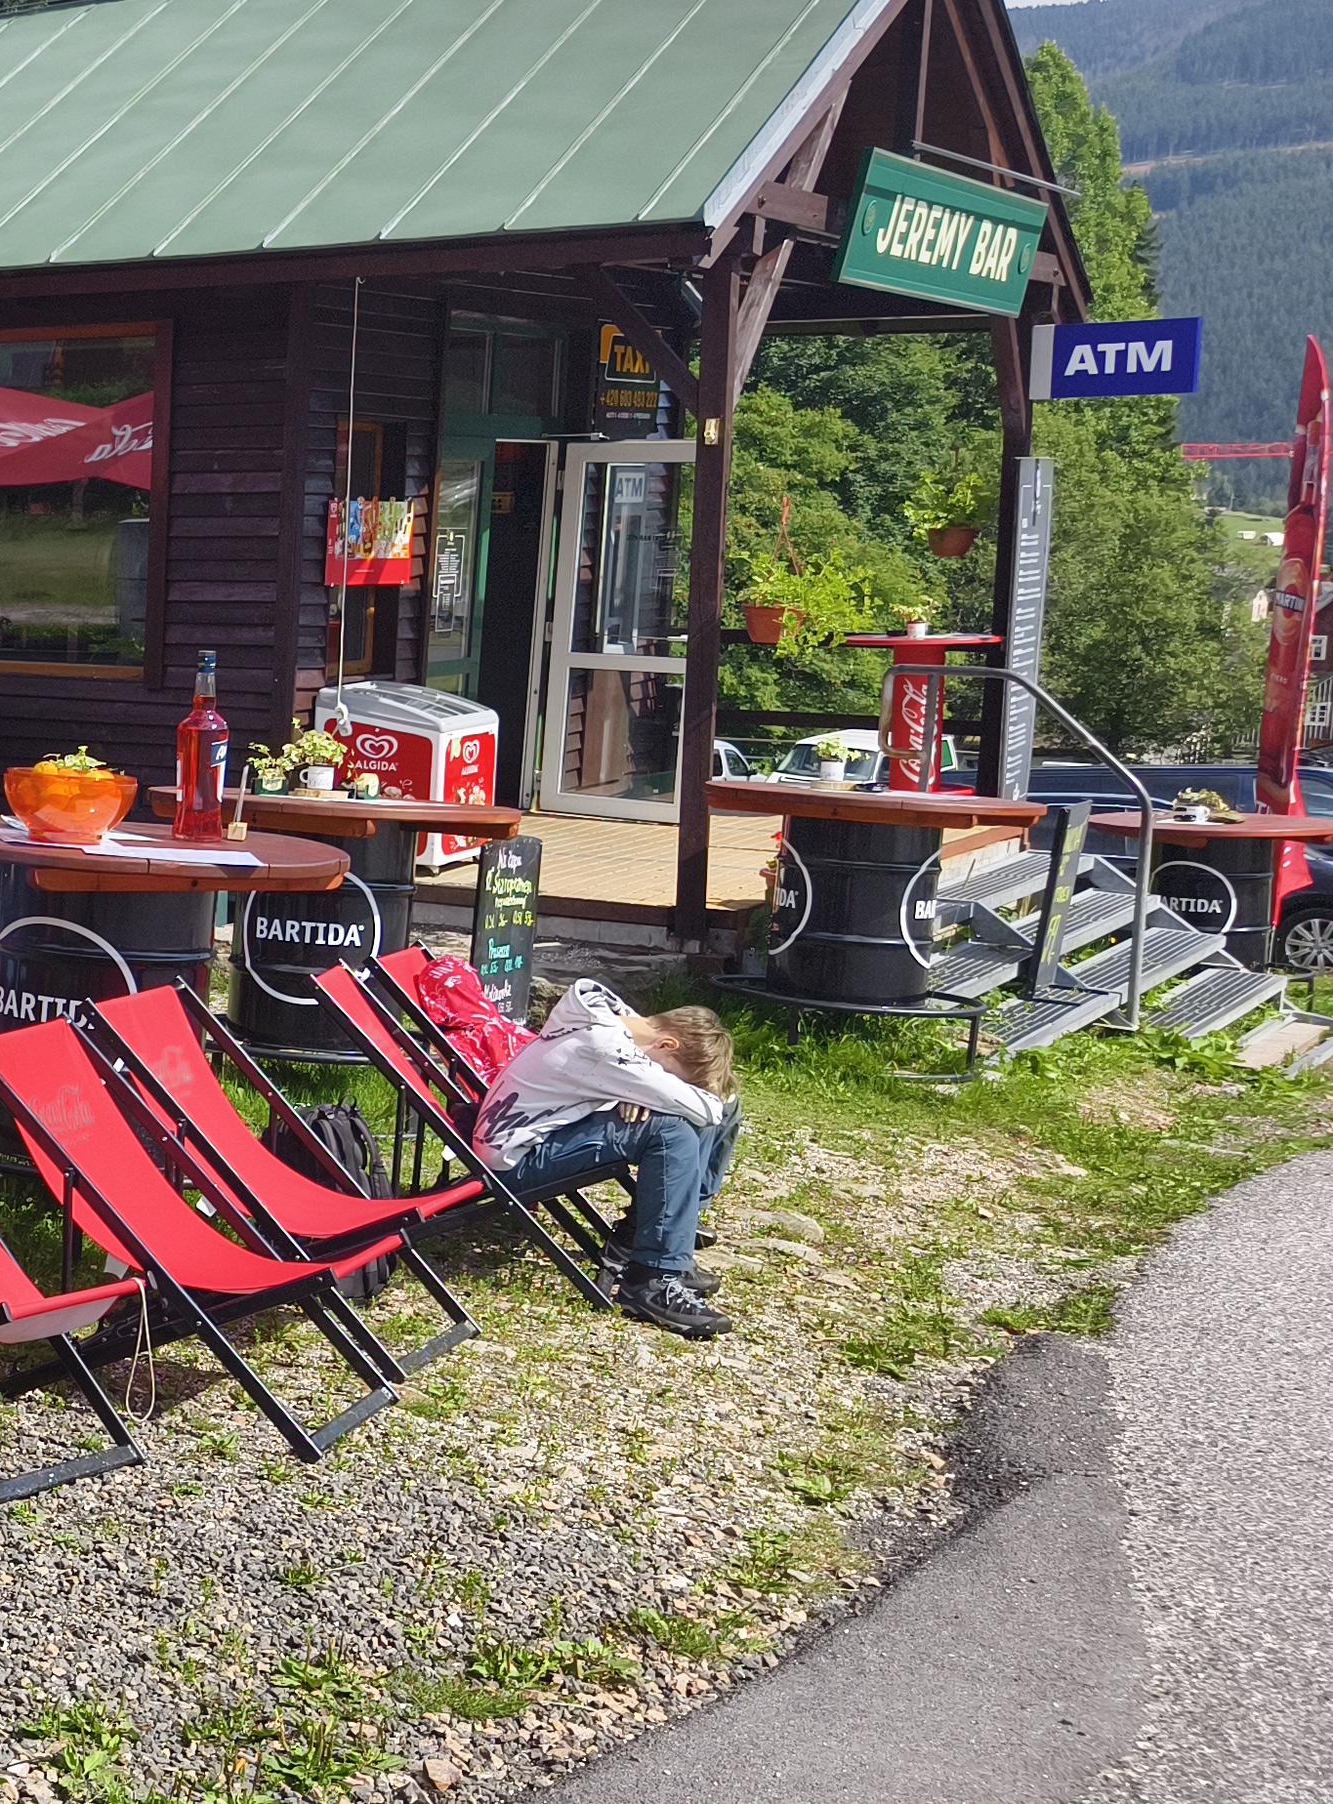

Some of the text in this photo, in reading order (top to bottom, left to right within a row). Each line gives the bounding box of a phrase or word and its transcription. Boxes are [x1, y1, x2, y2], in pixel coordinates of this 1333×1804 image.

[876, 194, 1019, 282] JEREMY BAR
[1064, 340, 1173, 376] ATM
[616, 477, 643, 497] ATM
[354, 760, 398, 772] ALGIDA
[1159, 895, 1223, 915] ARTIDA
[255, 916, 365, 947] BARTIDA
